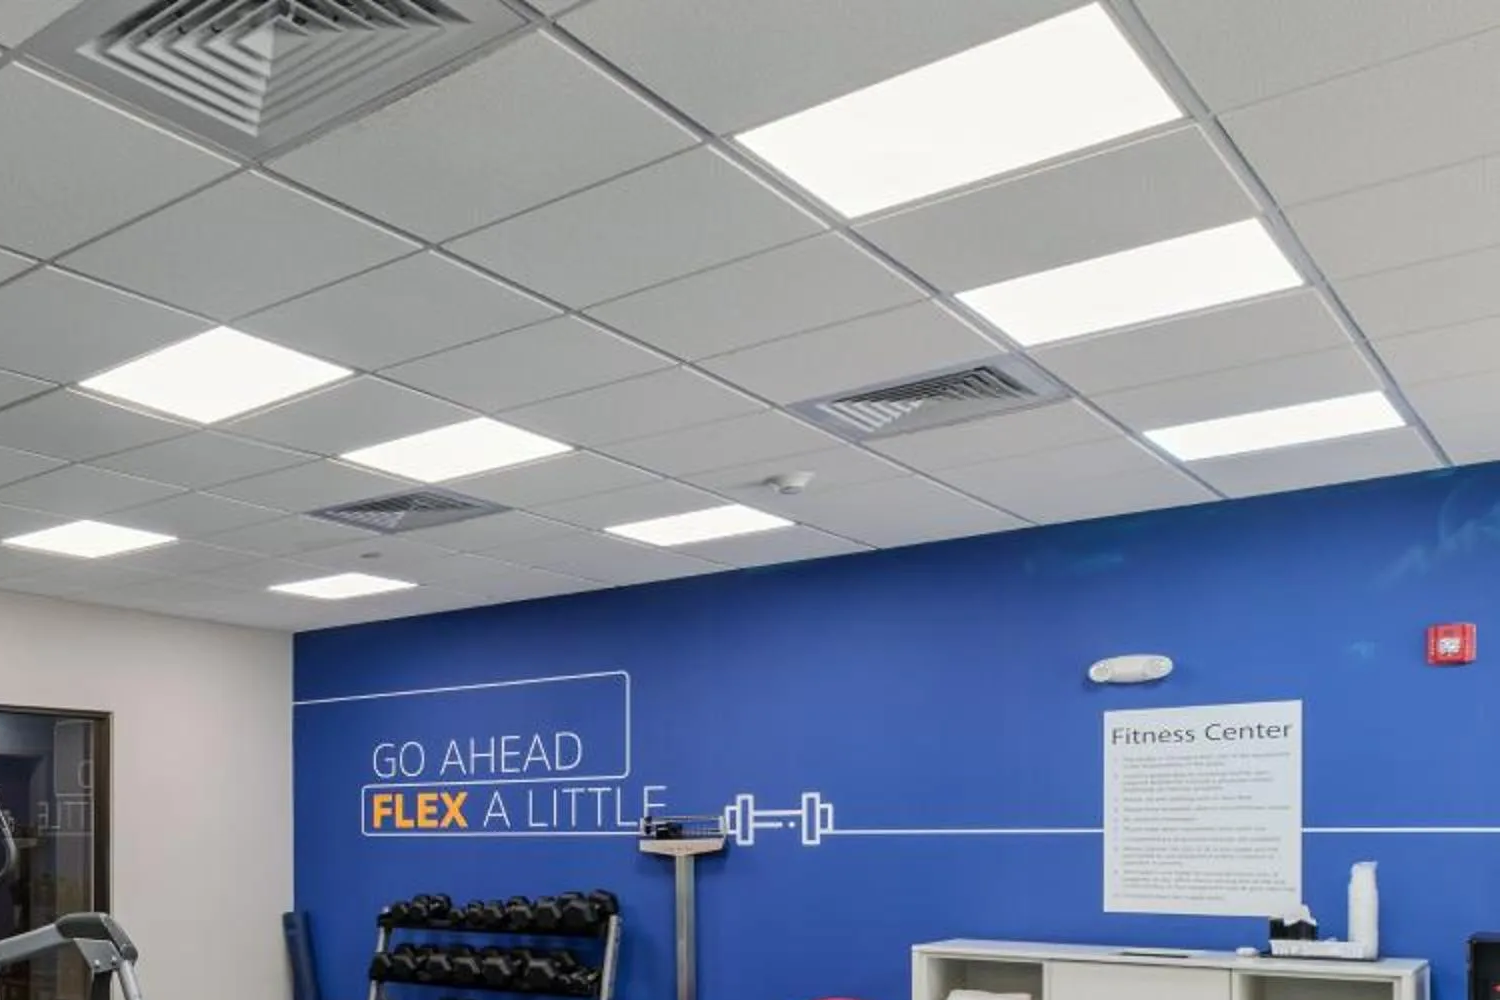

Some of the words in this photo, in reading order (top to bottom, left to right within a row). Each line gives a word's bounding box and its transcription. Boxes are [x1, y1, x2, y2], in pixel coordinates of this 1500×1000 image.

[373, 741, 425, 778] GO
[439, 731, 583, 775] AHEAD
[1111, 726, 1195, 746] Fitness
[1204, 721, 1293, 742] Center
[372, 791, 469, 830] FLEX
[483, 790, 511, 828] A
[528, 785, 667, 828] LITTLE
